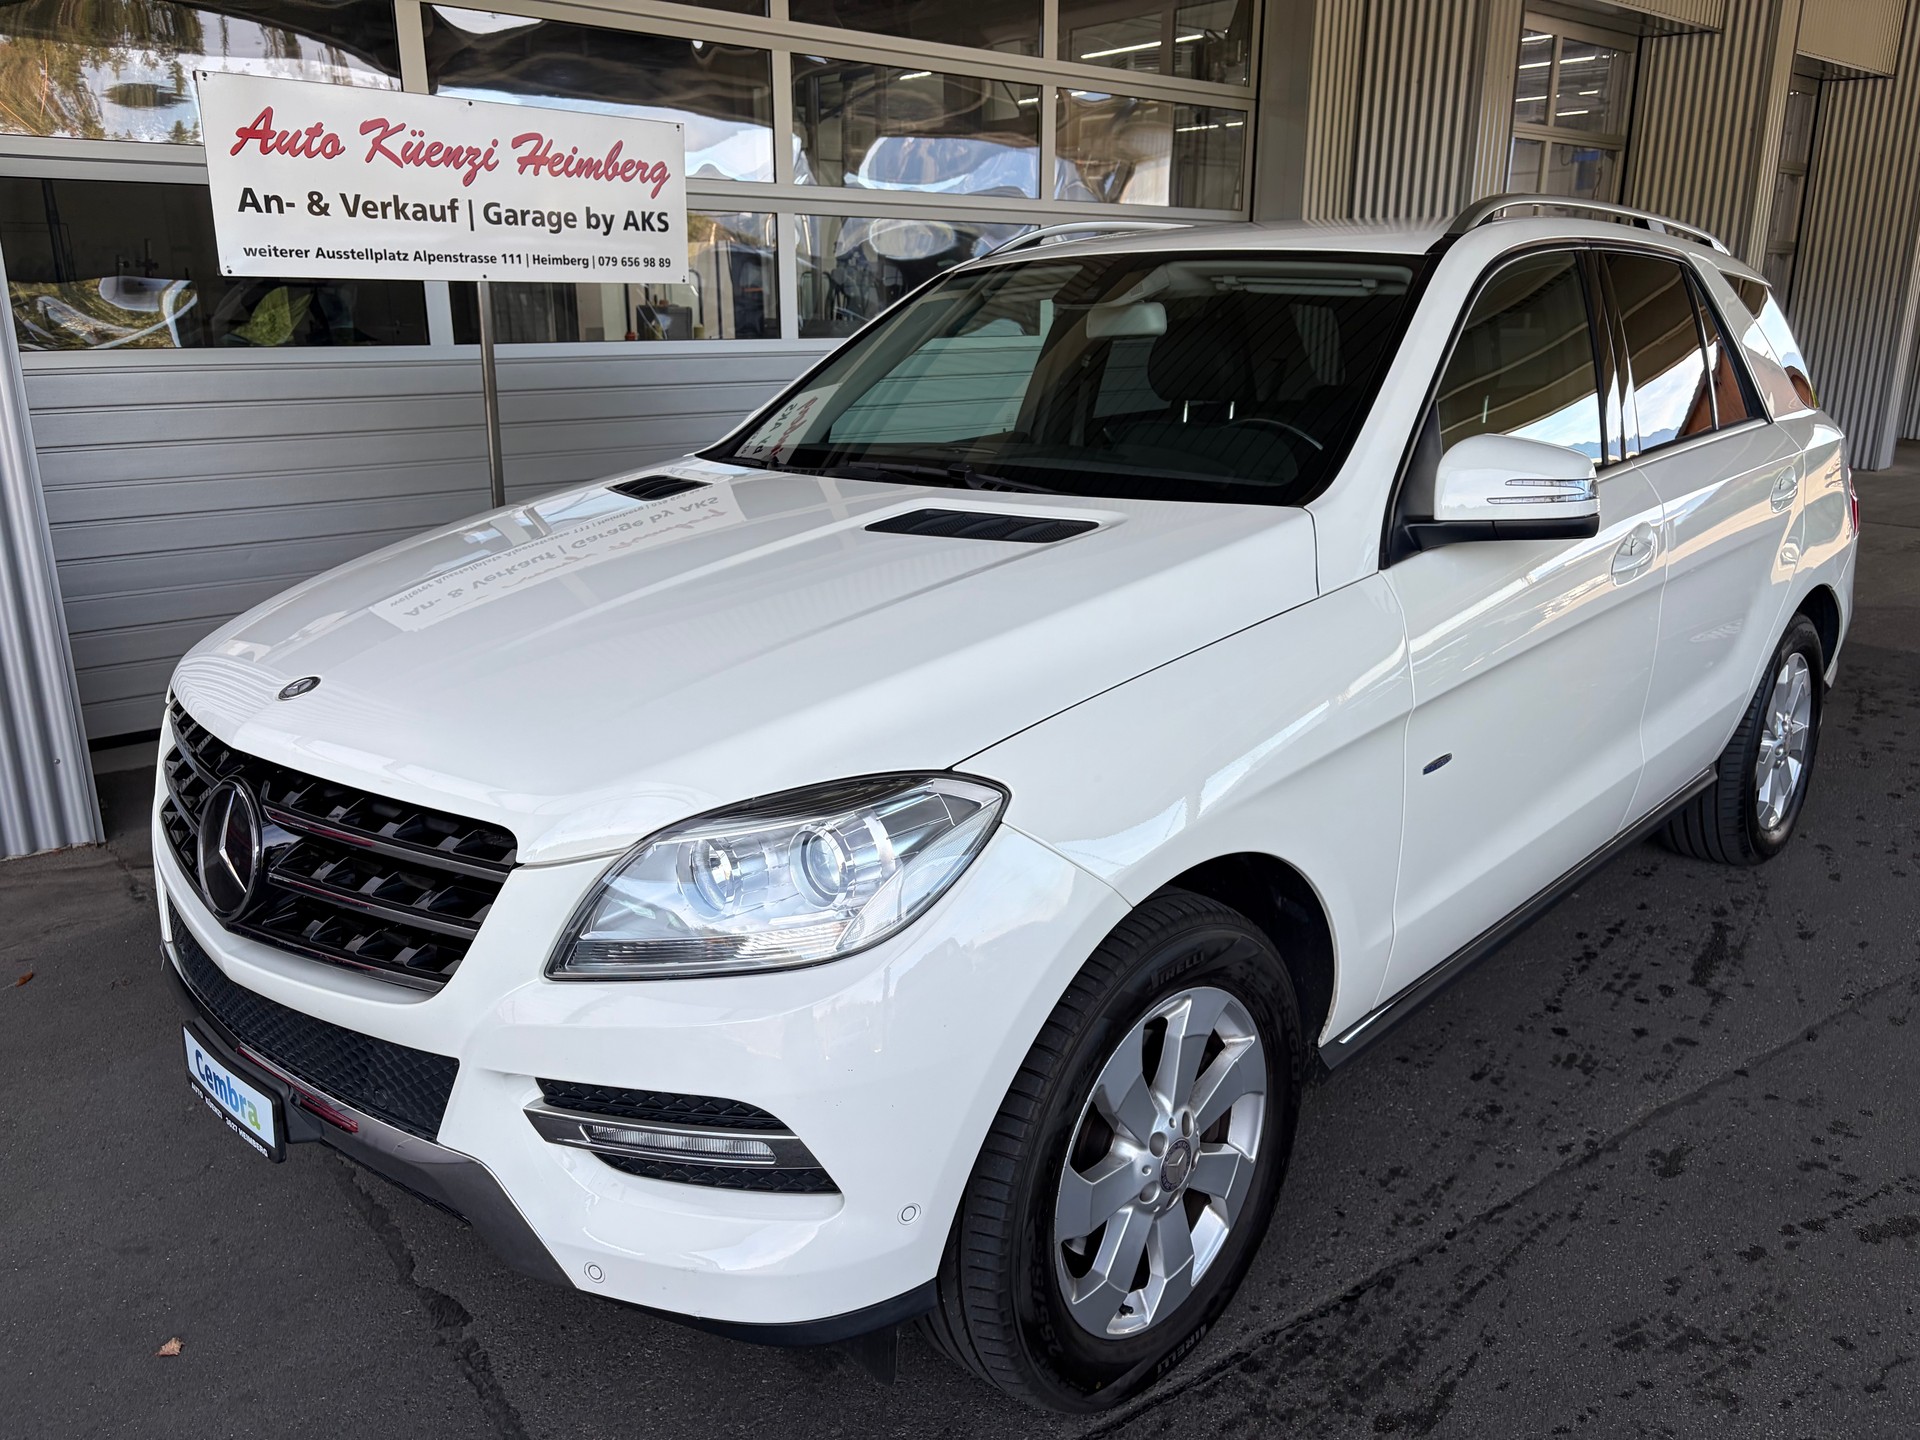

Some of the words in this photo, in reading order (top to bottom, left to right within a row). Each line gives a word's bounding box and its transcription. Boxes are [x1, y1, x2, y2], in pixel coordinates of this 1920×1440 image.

[229, 105, 346, 161] Auto
[358, 117, 499, 188] Küenzi
[510, 132, 671, 200] Heimberg
[237, 187, 296, 215] An-
[307, 190, 331, 217] &
[339, 192, 460, 223] Verkauf
[483, 202, 578, 235] Garage
[585, 206, 615, 237] by
[622, 210, 670, 233] AKS
[243, 244, 311, 259] weiterer
[315, 247, 409, 264] Ausstellplatz
[413, 249, 498, 265] Alpenstrasse
[501, 253, 522, 265] 111
[532, 254, 589, 269] Heimberg
[597, 256, 618, 267] 079
[620, 256, 641, 268] 656
[643, 257, 656, 268] 98
[658, 257, 671, 268] 89
[195, 1049, 261, 1131] Cembra
